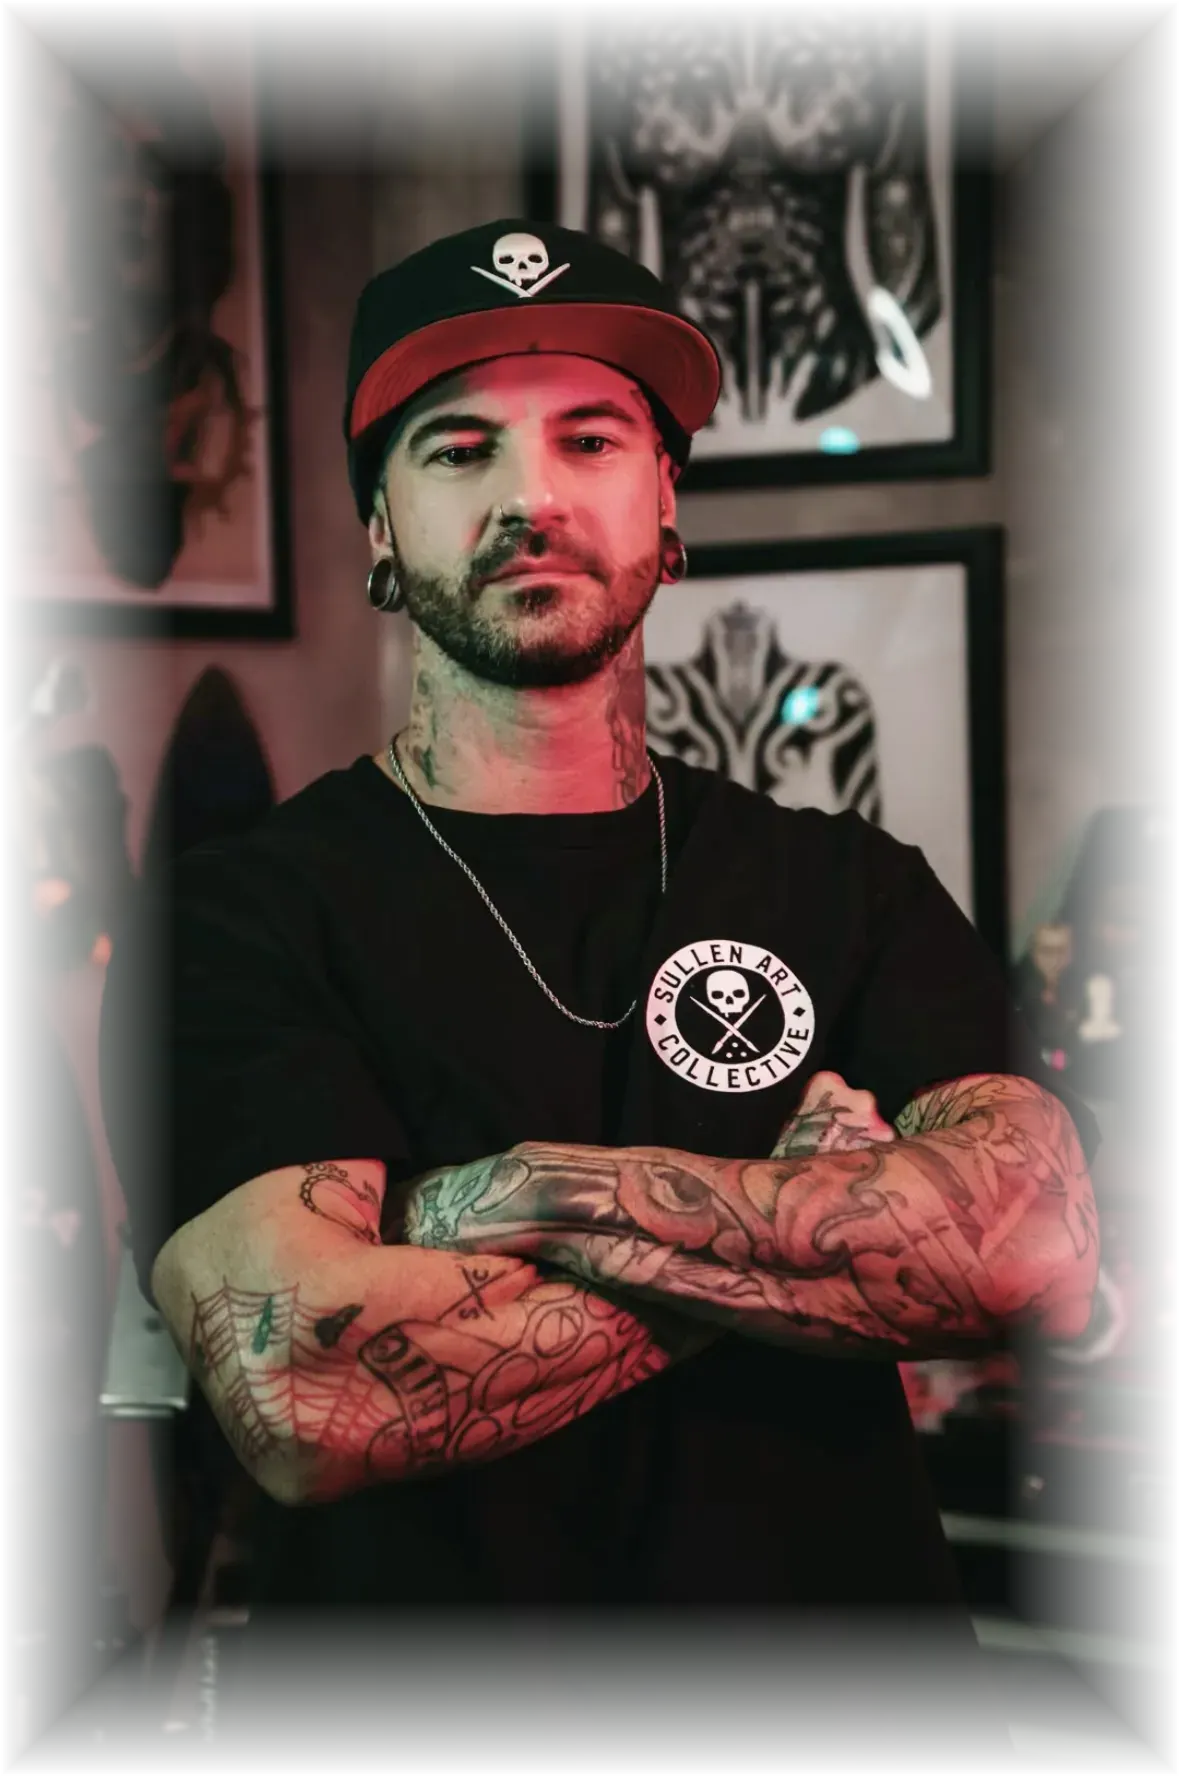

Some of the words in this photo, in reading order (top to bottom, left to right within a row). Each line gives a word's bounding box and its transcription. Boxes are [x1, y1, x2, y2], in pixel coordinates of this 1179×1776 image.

[654, 944, 743, 1004] SULLEN
[755, 954, 802, 997] ART
[657, 1027, 810, 1089] COLLECTIVE
